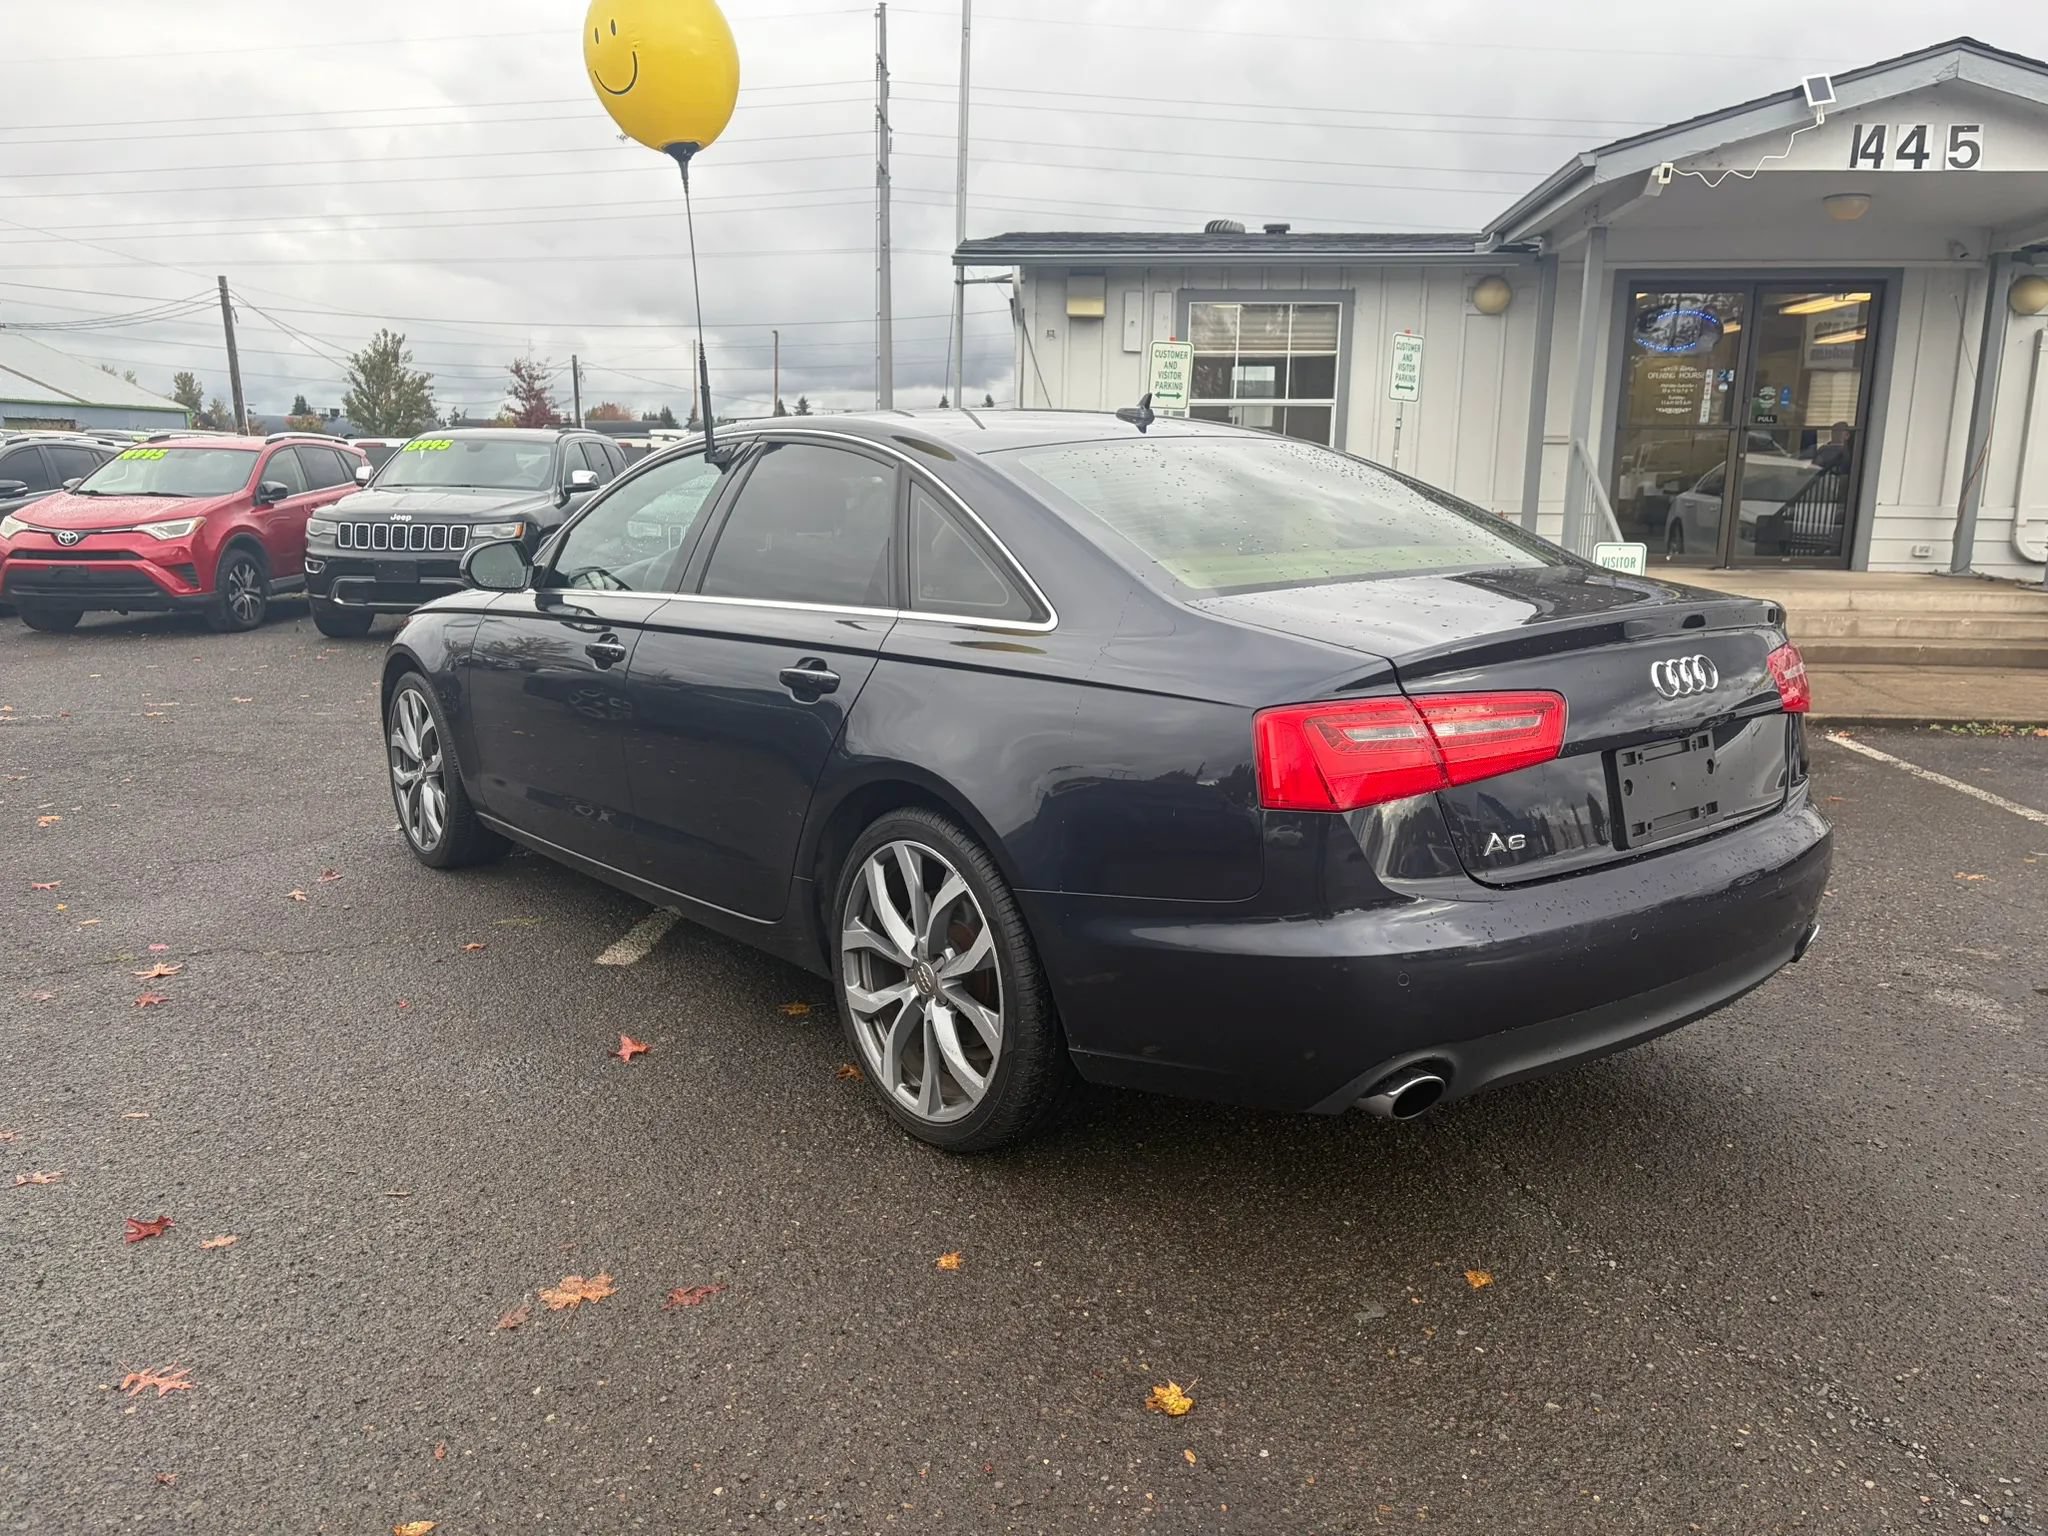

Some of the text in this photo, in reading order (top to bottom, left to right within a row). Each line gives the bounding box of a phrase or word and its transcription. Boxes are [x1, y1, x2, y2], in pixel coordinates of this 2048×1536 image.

[1849, 124, 1981, 169] 1445
[1396, 342, 1421, 352] CUSTOMER
[1154, 350, 1188, 359] CUSTOMER
[1402, 353, 1413, 362] AND
[1163, 361, 1178, 370] AND
[1397, 363, 1415, 373] VISITOR
[1158, 371, 1182, 380] VISITOR
[1395, 373, 1416, 383] PARKING
[1154, 381, 1183, 390] PARKING
[390, 513, 412, 521] Jeep
[1601, 556, 1637, 568] VISITOR
[1483, 832, 1526, 856] A6
